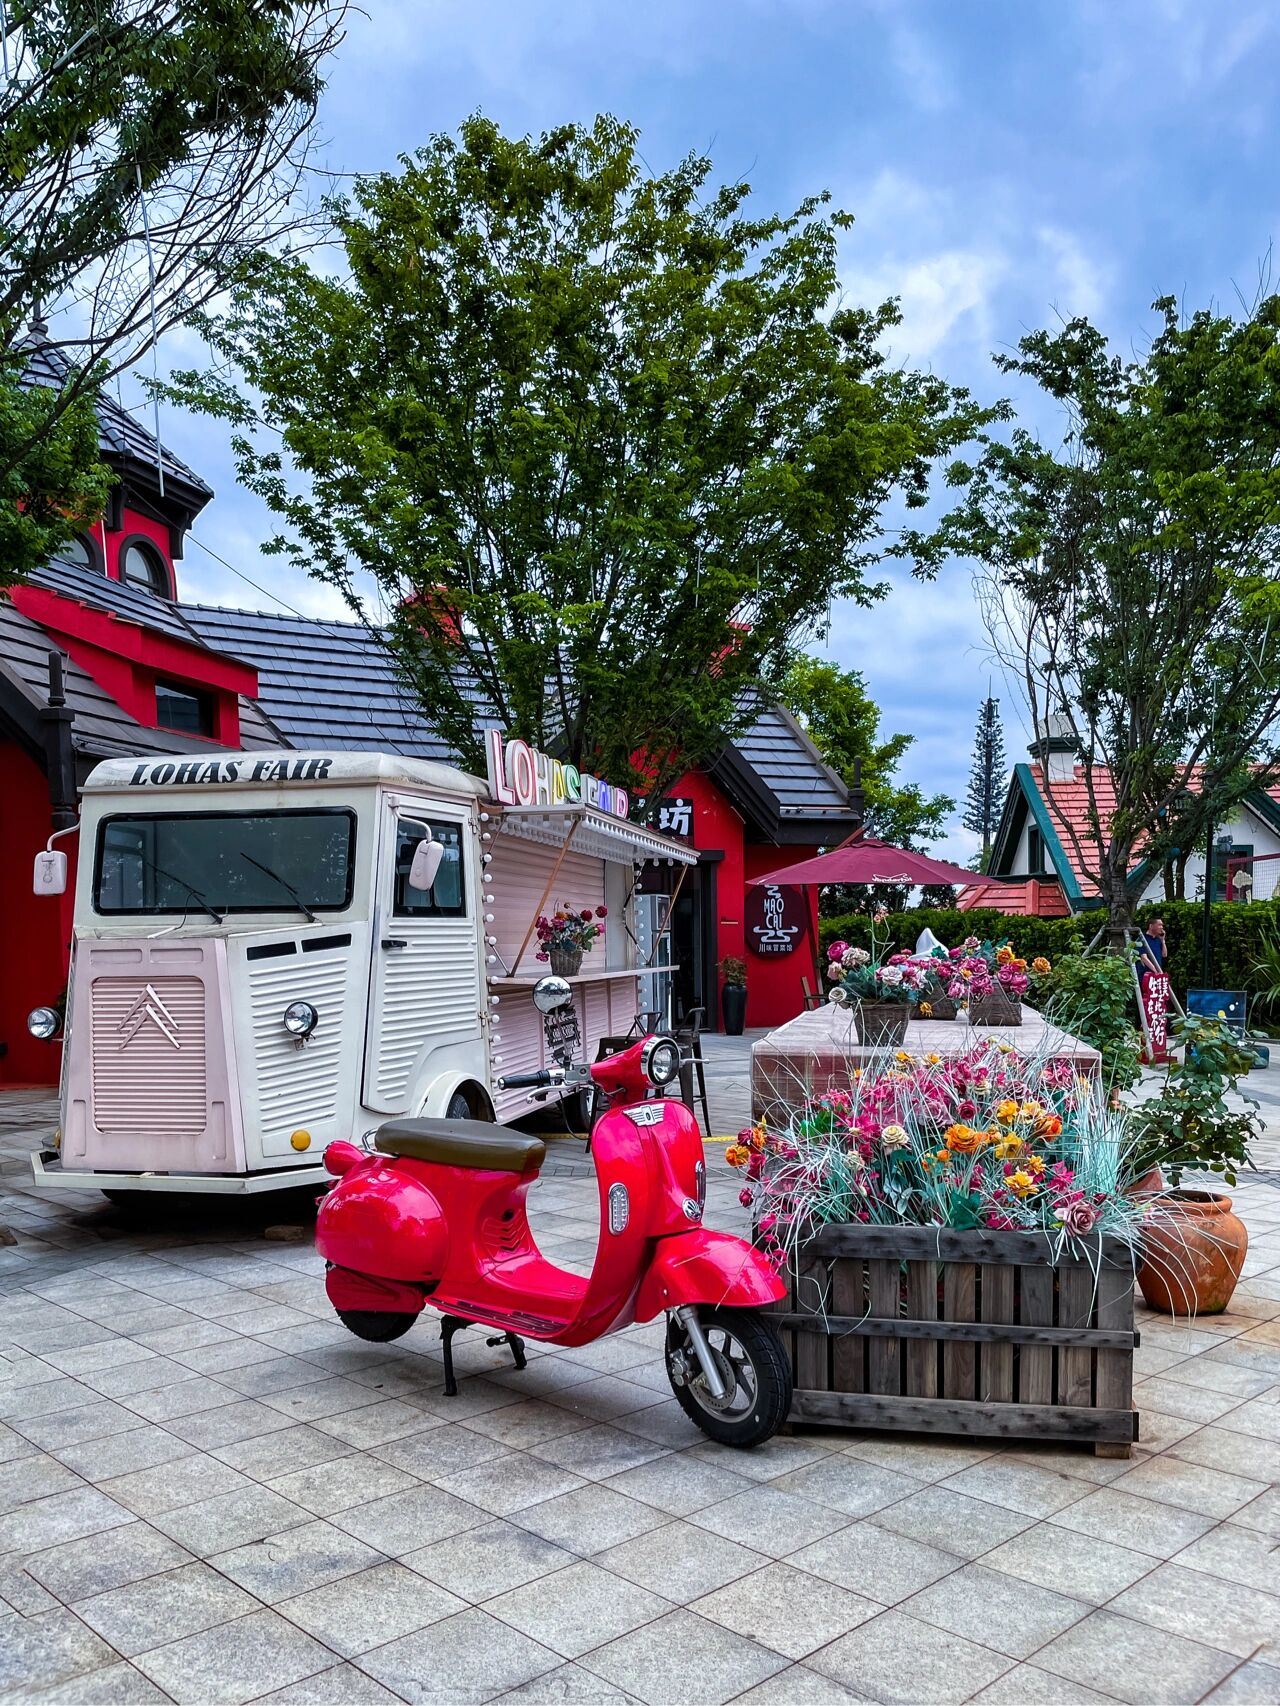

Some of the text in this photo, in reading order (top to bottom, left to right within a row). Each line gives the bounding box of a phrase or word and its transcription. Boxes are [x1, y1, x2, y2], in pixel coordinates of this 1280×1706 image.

[128, 758, 333, 785] LOHAS FAIR
[485, 728, 581, 806] LOHAS
[763, 898, 784, 914] MAO
[766, 913, 782, 930] CAI
